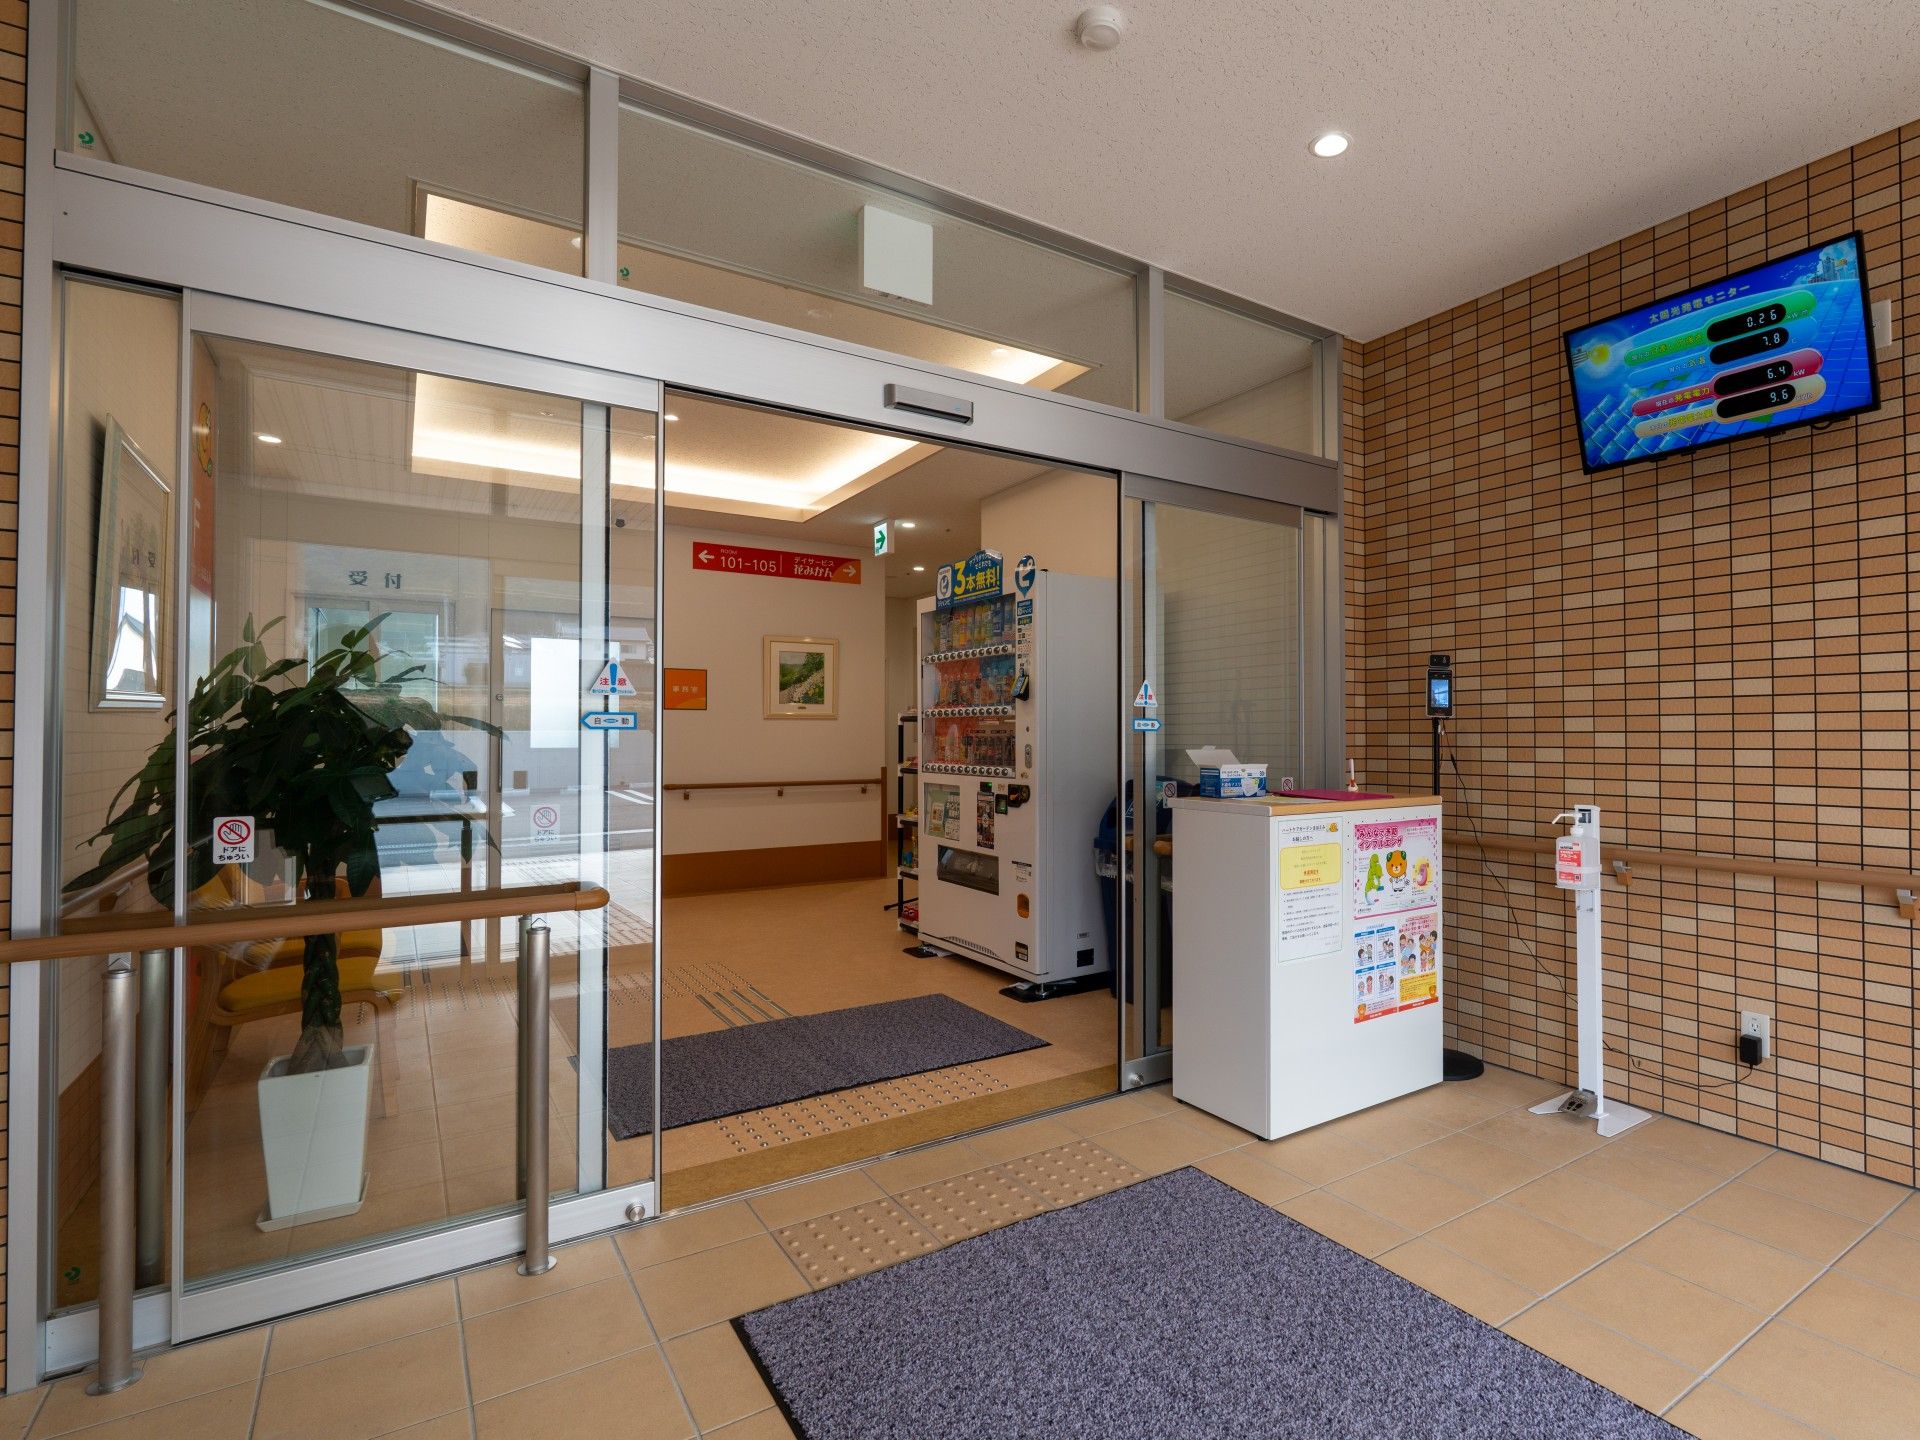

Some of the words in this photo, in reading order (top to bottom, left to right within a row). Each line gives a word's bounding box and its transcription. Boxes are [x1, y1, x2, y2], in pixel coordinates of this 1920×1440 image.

[1648, 284, 1751, 325] 太陽光発電モニター
[1746, 308, 1778, 328] 0.26
[1762, 332, 1781, 347] 7.8
[1766, 364, 1787, 380] 6.4
[1793, 368, 1806, 377] kW
[1770, 388, 1789, 404] 9.6
[794, 556, 835, 568] デイサービス
[793, 564, 833, 578] 花みかん
[348, 570, 402, 590] 受付
[672, 684, 699, 694] 事務室
[1358, 837, 1404, 852] インフルエンザ
